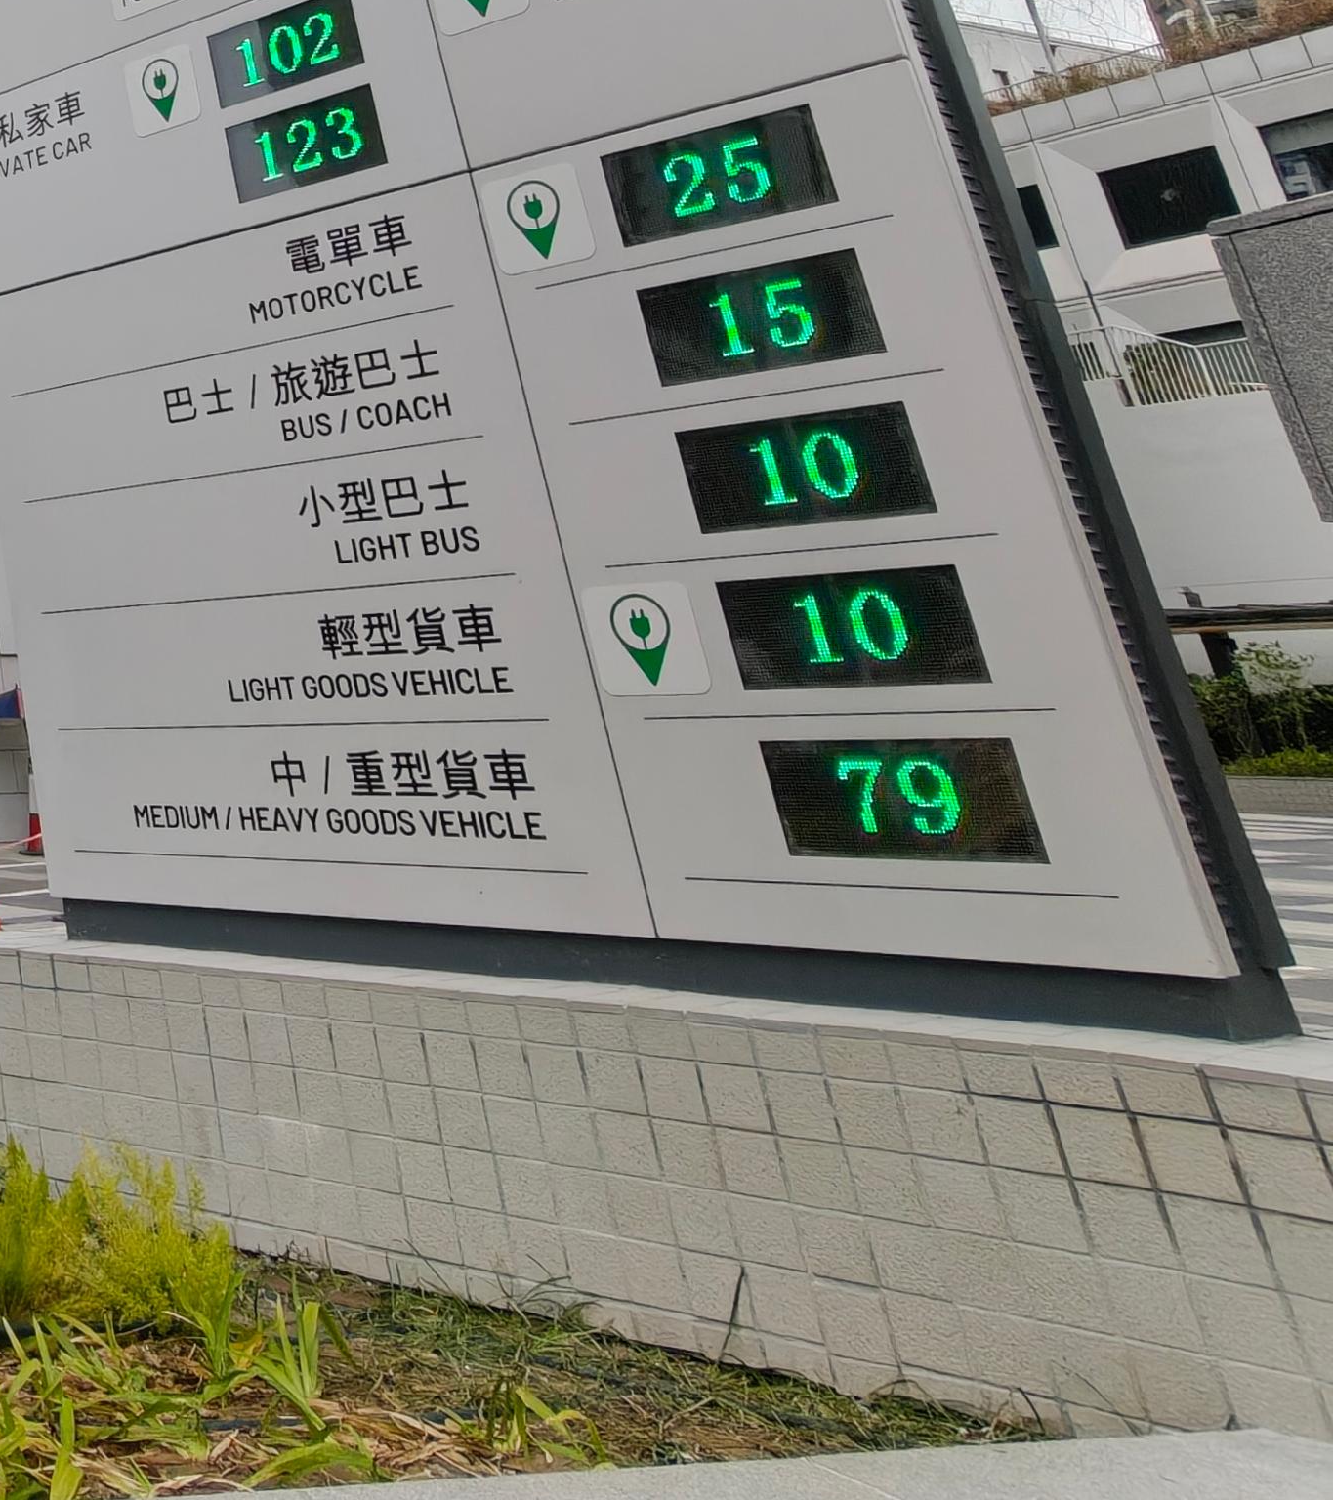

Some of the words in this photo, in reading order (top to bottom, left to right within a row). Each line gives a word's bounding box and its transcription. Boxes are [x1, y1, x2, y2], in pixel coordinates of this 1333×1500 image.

[236, 12, 340, 87] 102
[52, 132, 92, 158] CAR
[254, 106, 364, 182] 123
[663, 133, 773, 218] 25
[286, 214, 412, 274] 電單車
[249, 266, 423, 324] MOTORCYCLE
[709, 277, 815, 356] 15
[163, 379, 233, 424] 巴士
[271, 339, 440, 407] 旅遊巴士
[281, 413, 332, 441] BUS
[356, 392, 452, 430] COACH
[749, 431, 859, 505] 10
[299, 469, 469, 528] 小型巴士
[334, 532, 410, 564] LIGHT
[422, 526, 480, 557] BUS
[317, 603, 502, 660] 輕型貨車
[793, 589, 910, 663] 10
[228, 676, 295, 702] LIGHT
[302, 673, 388, 699] GOODS
[392, 667, 514, 696] VEHICLE
[271, 751, 306, 797] 中
[346, 748, 535, 800] 重型貨車
[838, 760, 962, 835] 79
[134, 805, 219, 830] MEDIUM
[239, 807, 319, 833] HEAVY
[326, 809, 416, 836] GOODS
[419, 810, 547, 840] VEHICLE
